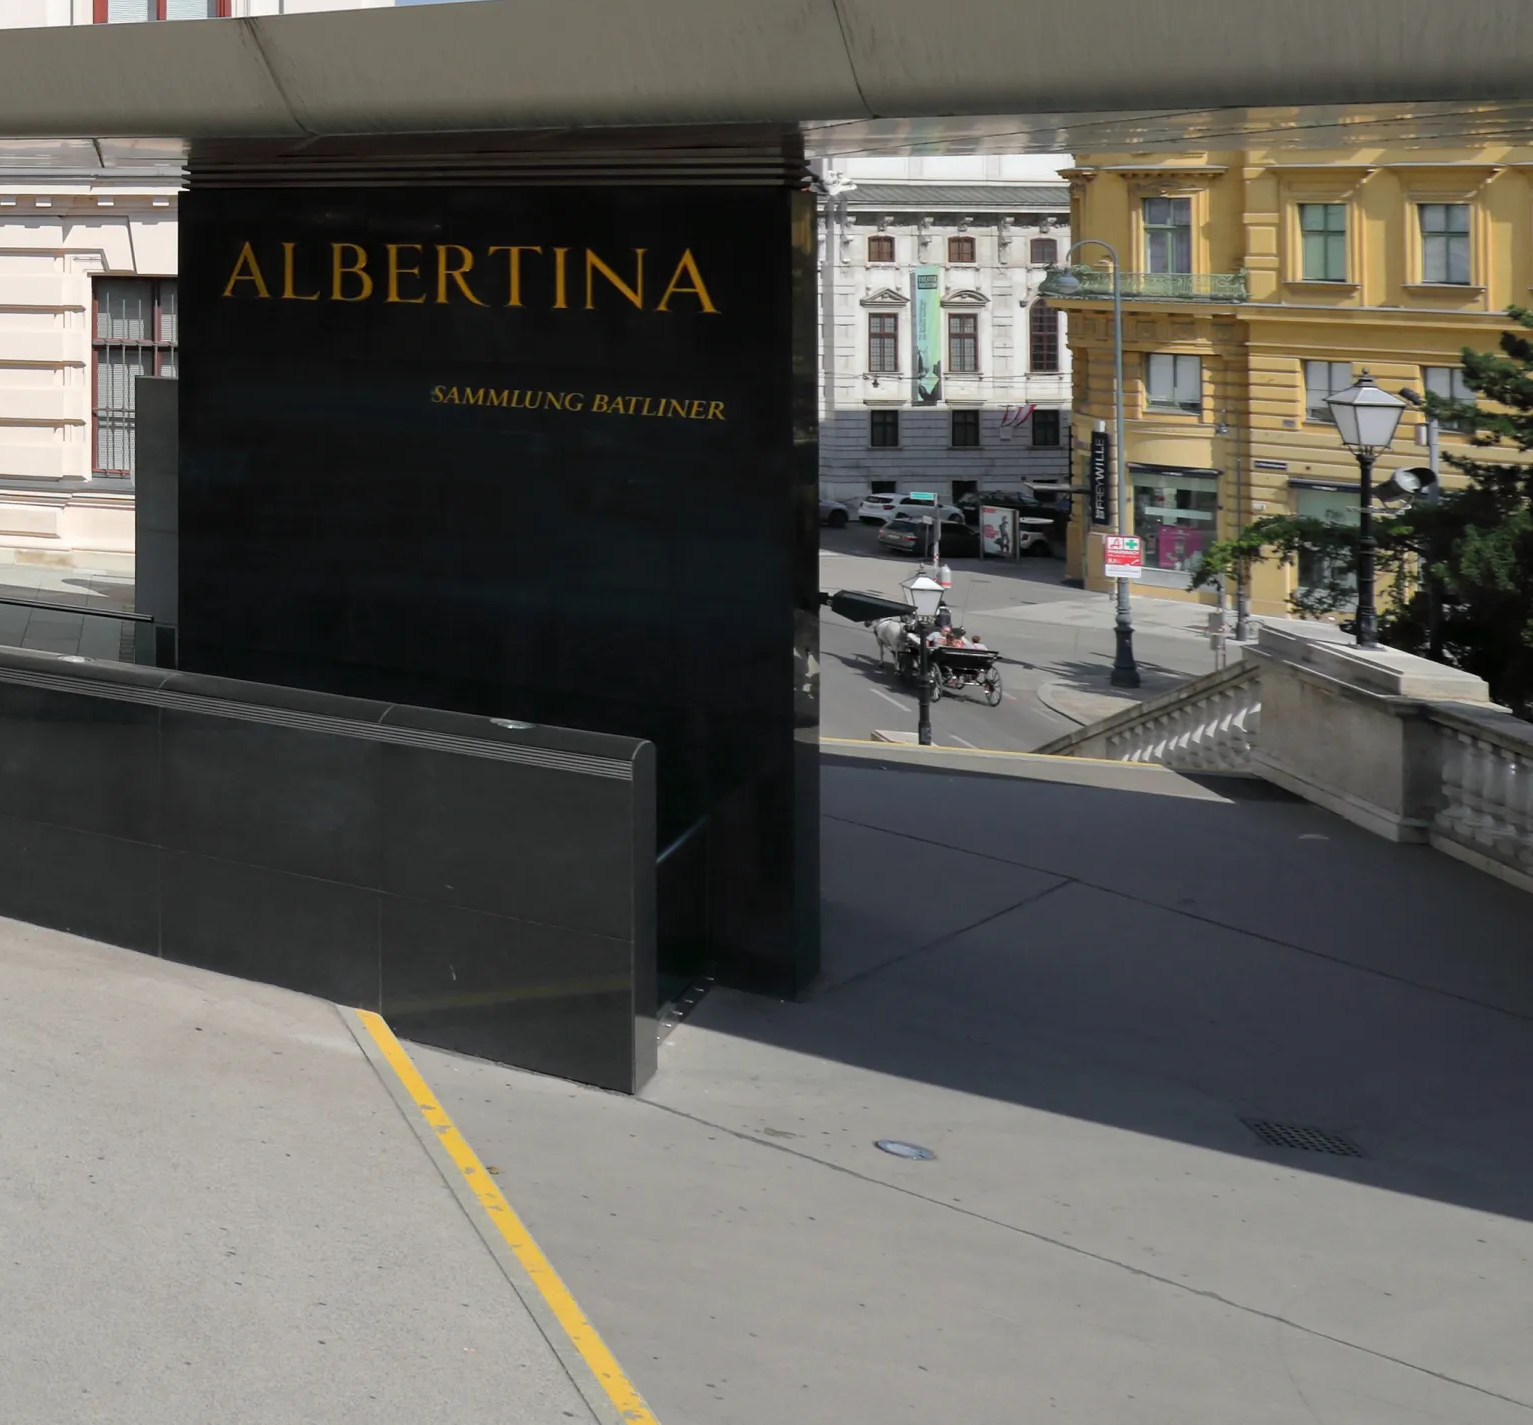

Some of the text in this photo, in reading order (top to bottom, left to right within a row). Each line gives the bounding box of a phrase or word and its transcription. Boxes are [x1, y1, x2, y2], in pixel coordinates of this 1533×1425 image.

[222, 240, 722, 315] ALBERTINA
[430, 384, 727, 422] SAMMLUNG BATLINER
